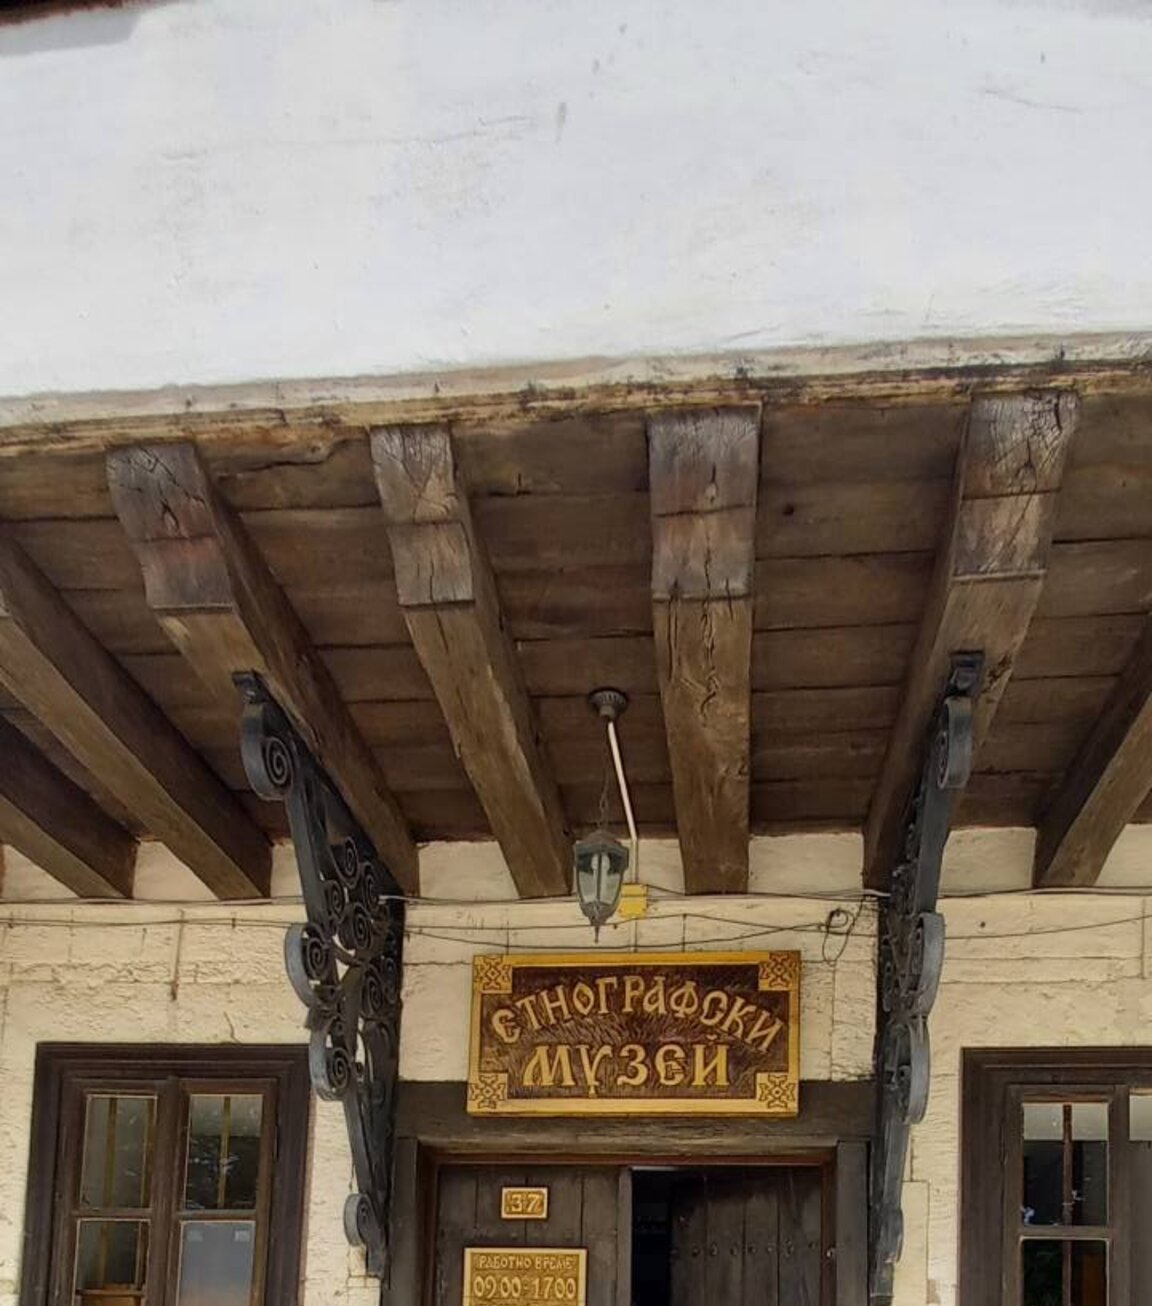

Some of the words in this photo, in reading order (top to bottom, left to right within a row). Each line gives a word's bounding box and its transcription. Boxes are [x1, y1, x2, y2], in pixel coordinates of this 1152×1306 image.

[492, 976, 786, 1053] ЕТНОГРАФСКИ
[522, 1033, 731, 1098] МУЗЕЙ
[510, 1193, 541, 1213] 37
[478, 1255, 532, 1270] РАБОТНО
